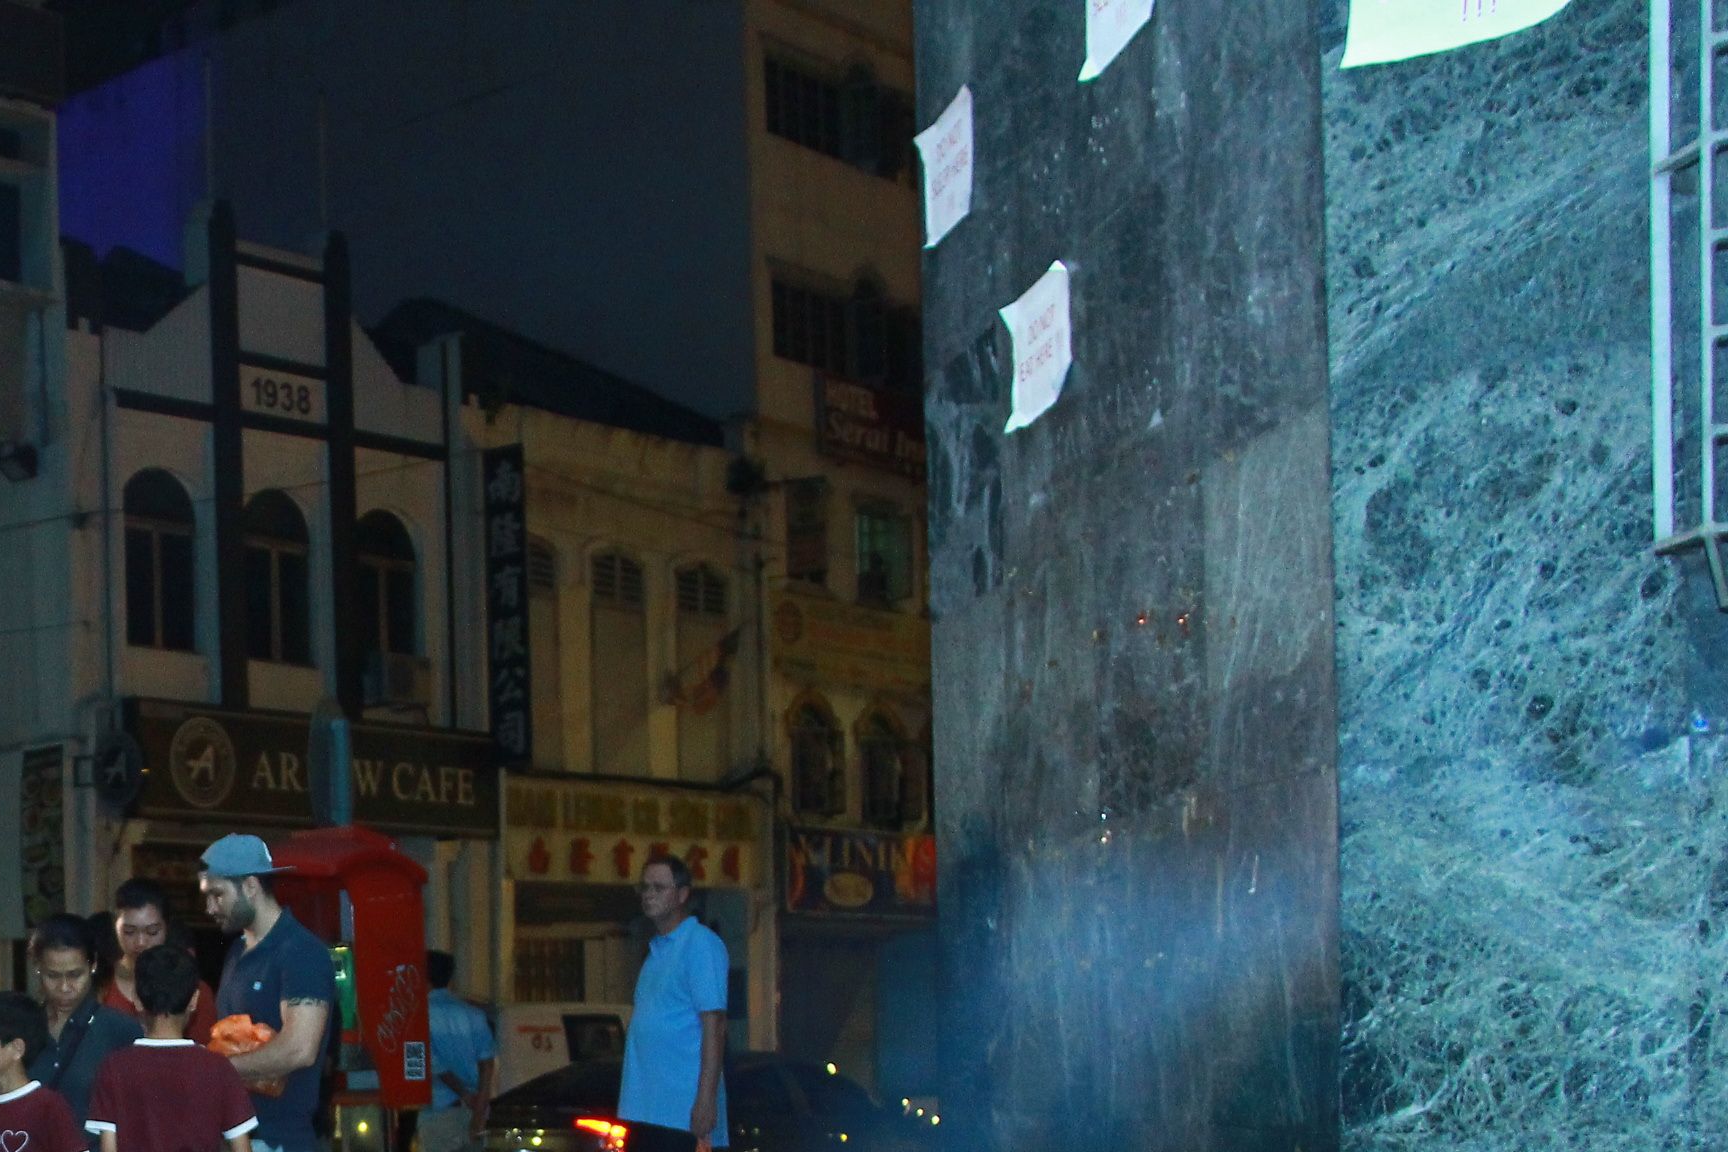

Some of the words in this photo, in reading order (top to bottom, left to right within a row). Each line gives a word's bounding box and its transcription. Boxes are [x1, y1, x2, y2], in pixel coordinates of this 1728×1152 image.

[249, 375, 313, 417] 1938
[252, 751, 384, 797] ARW
[391, 761, 475, 805] CAFE
